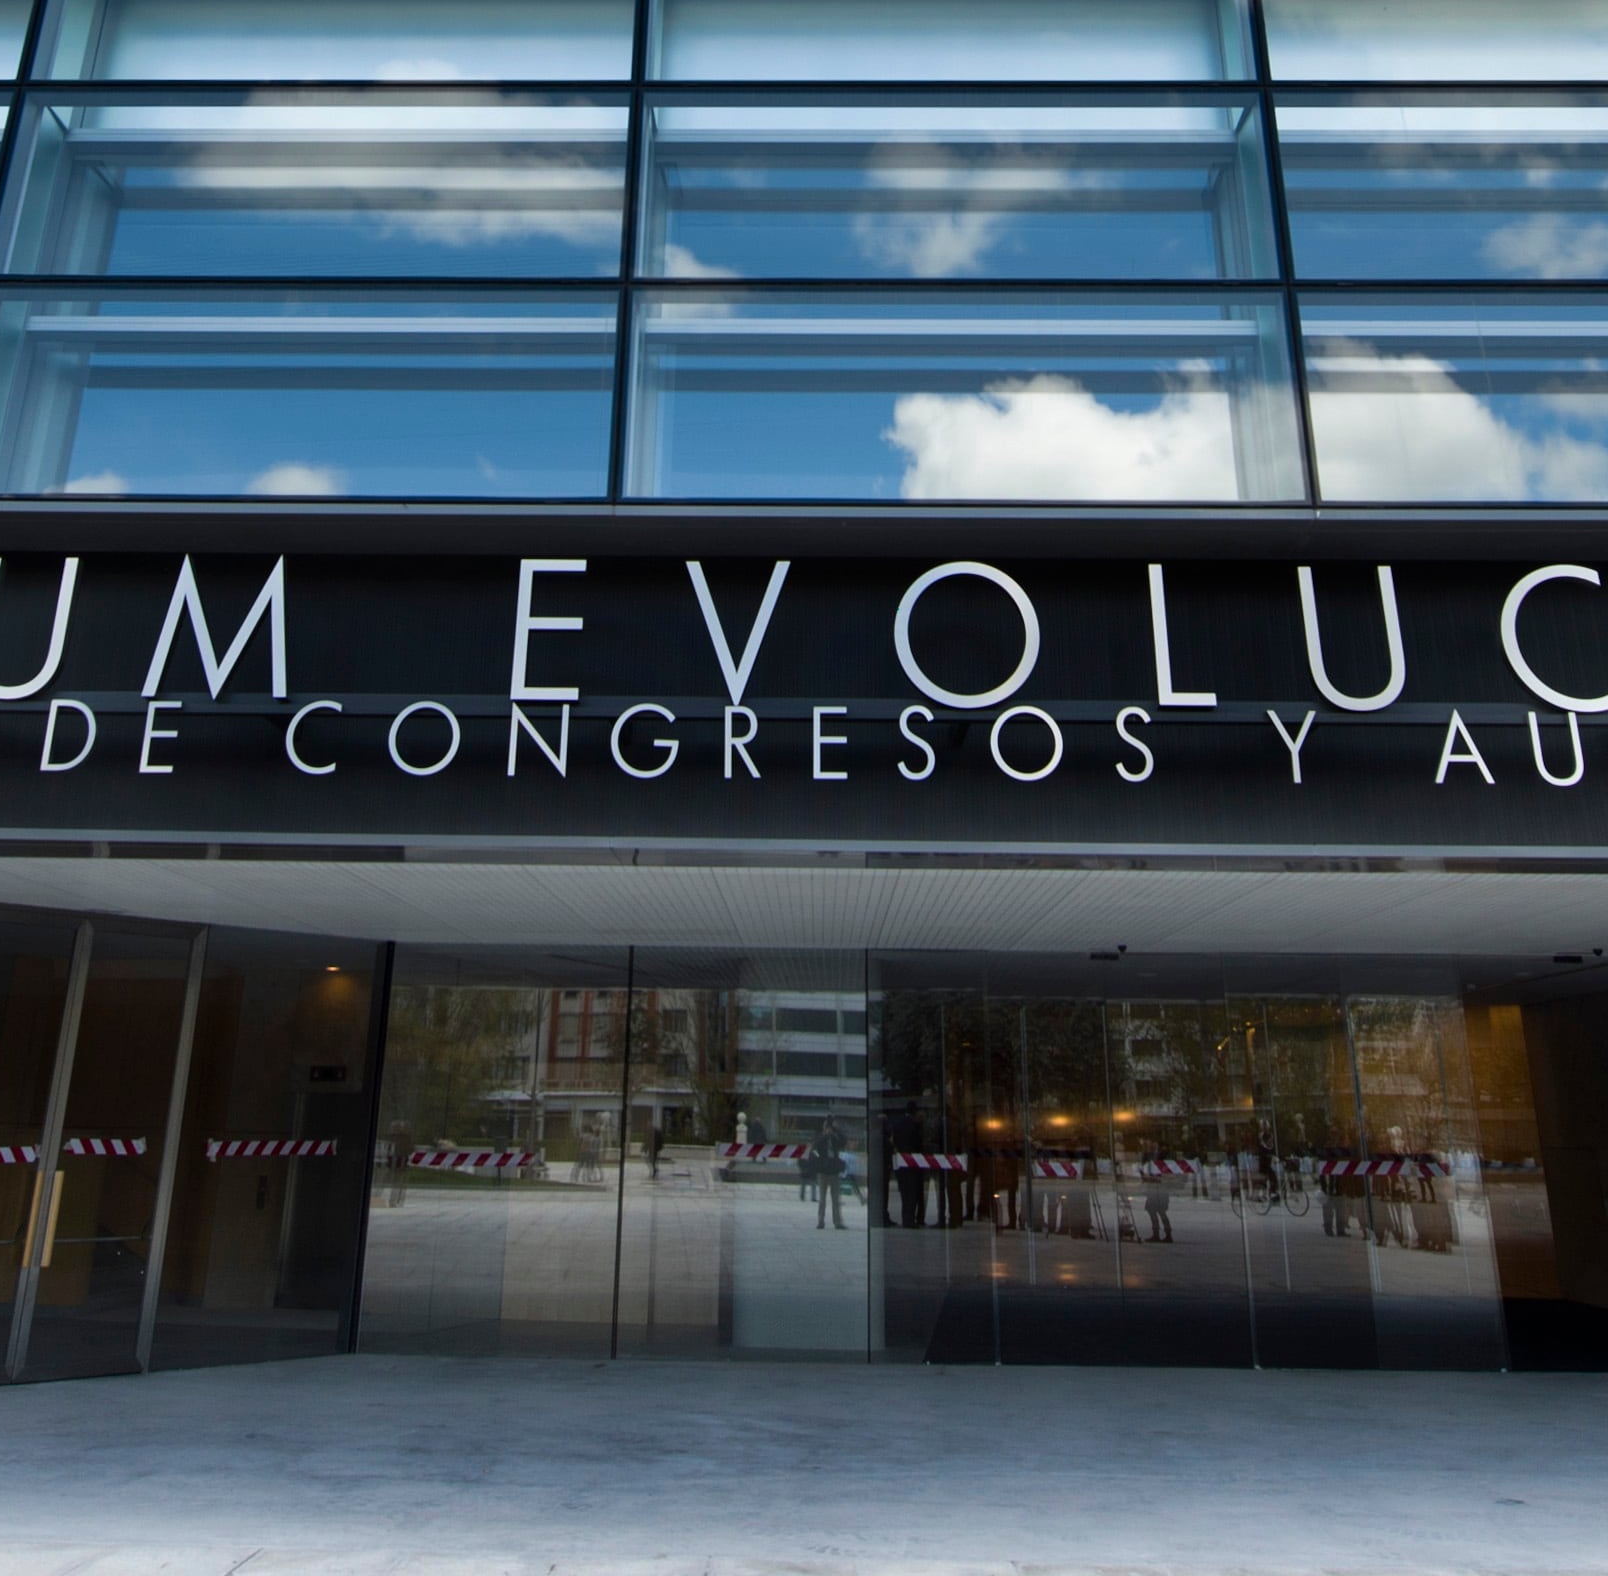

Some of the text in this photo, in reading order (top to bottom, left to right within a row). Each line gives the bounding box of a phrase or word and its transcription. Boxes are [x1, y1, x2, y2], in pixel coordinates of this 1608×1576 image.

[39, 699, 183, 773] DE
[285, 700, 1154, 782] CONGRESOS
[1266, 709, 1316, 784] Y
